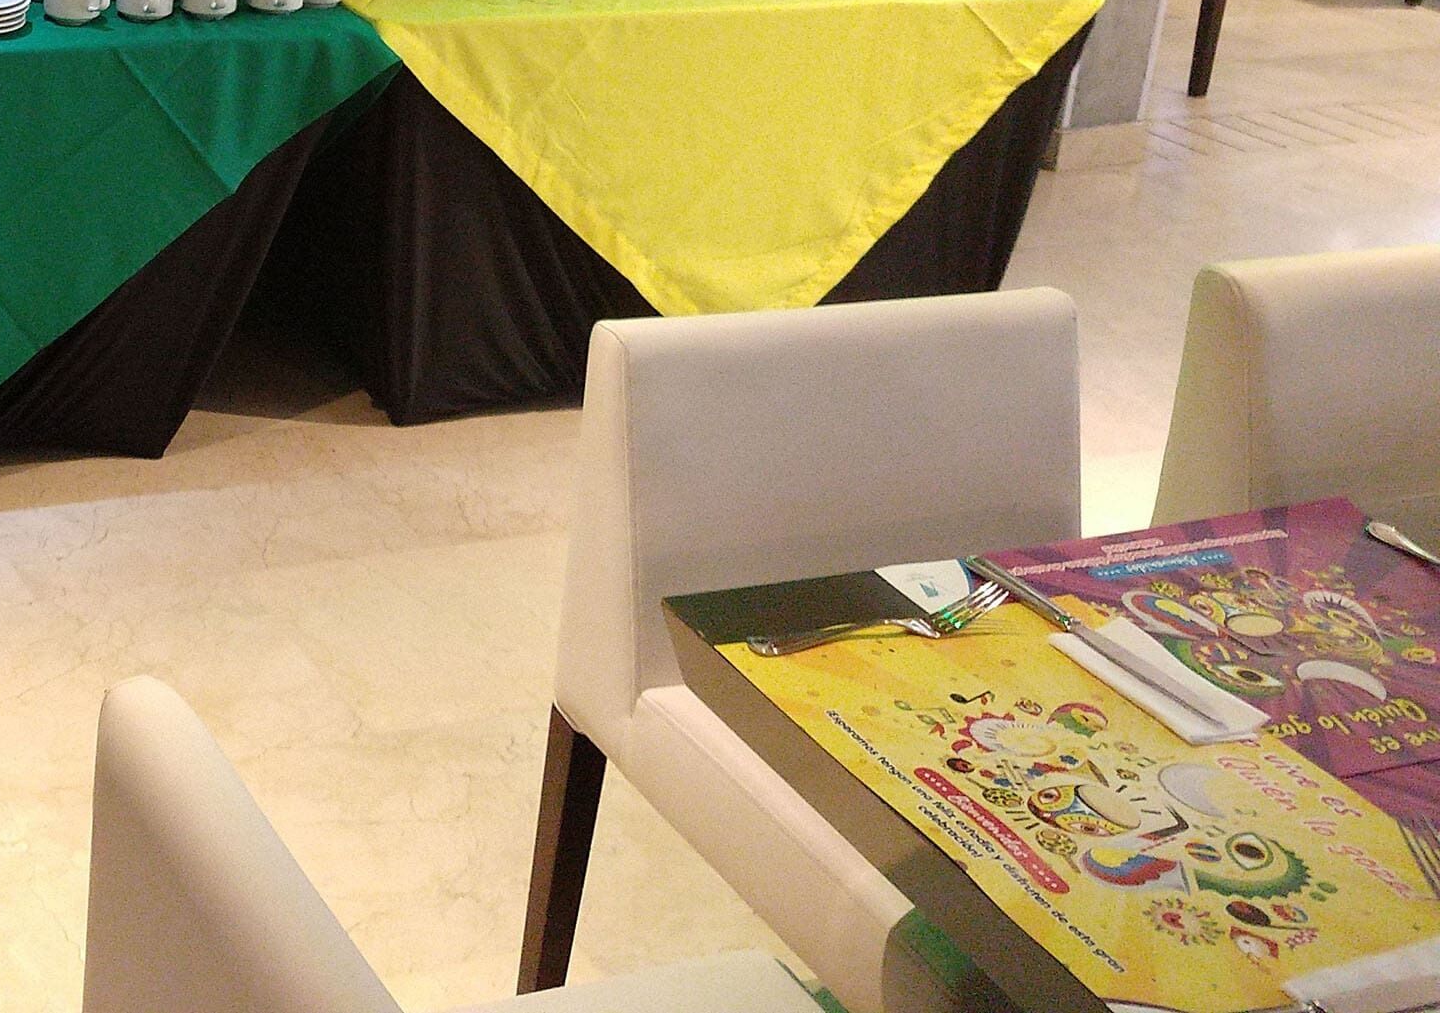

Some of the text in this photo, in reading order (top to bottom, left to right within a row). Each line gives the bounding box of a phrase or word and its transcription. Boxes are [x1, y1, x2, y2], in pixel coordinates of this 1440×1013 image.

[1262, 698, 1427, 738] Quién lo goz
[947, 794, 1029, 859] Bienvenidos
[1303, 819, 1339, 838] lo
[878, 755, 913, 785] tengan
[911, 784, 934, 801] una
[932, 800, 957, 819] feliz
[1002, 862, 1051, 909] disfruten
[1050, 909, 1069, 924] de
[1068, 924, 1096, 948] esta
[1092, 947, 1126, 973] gran
